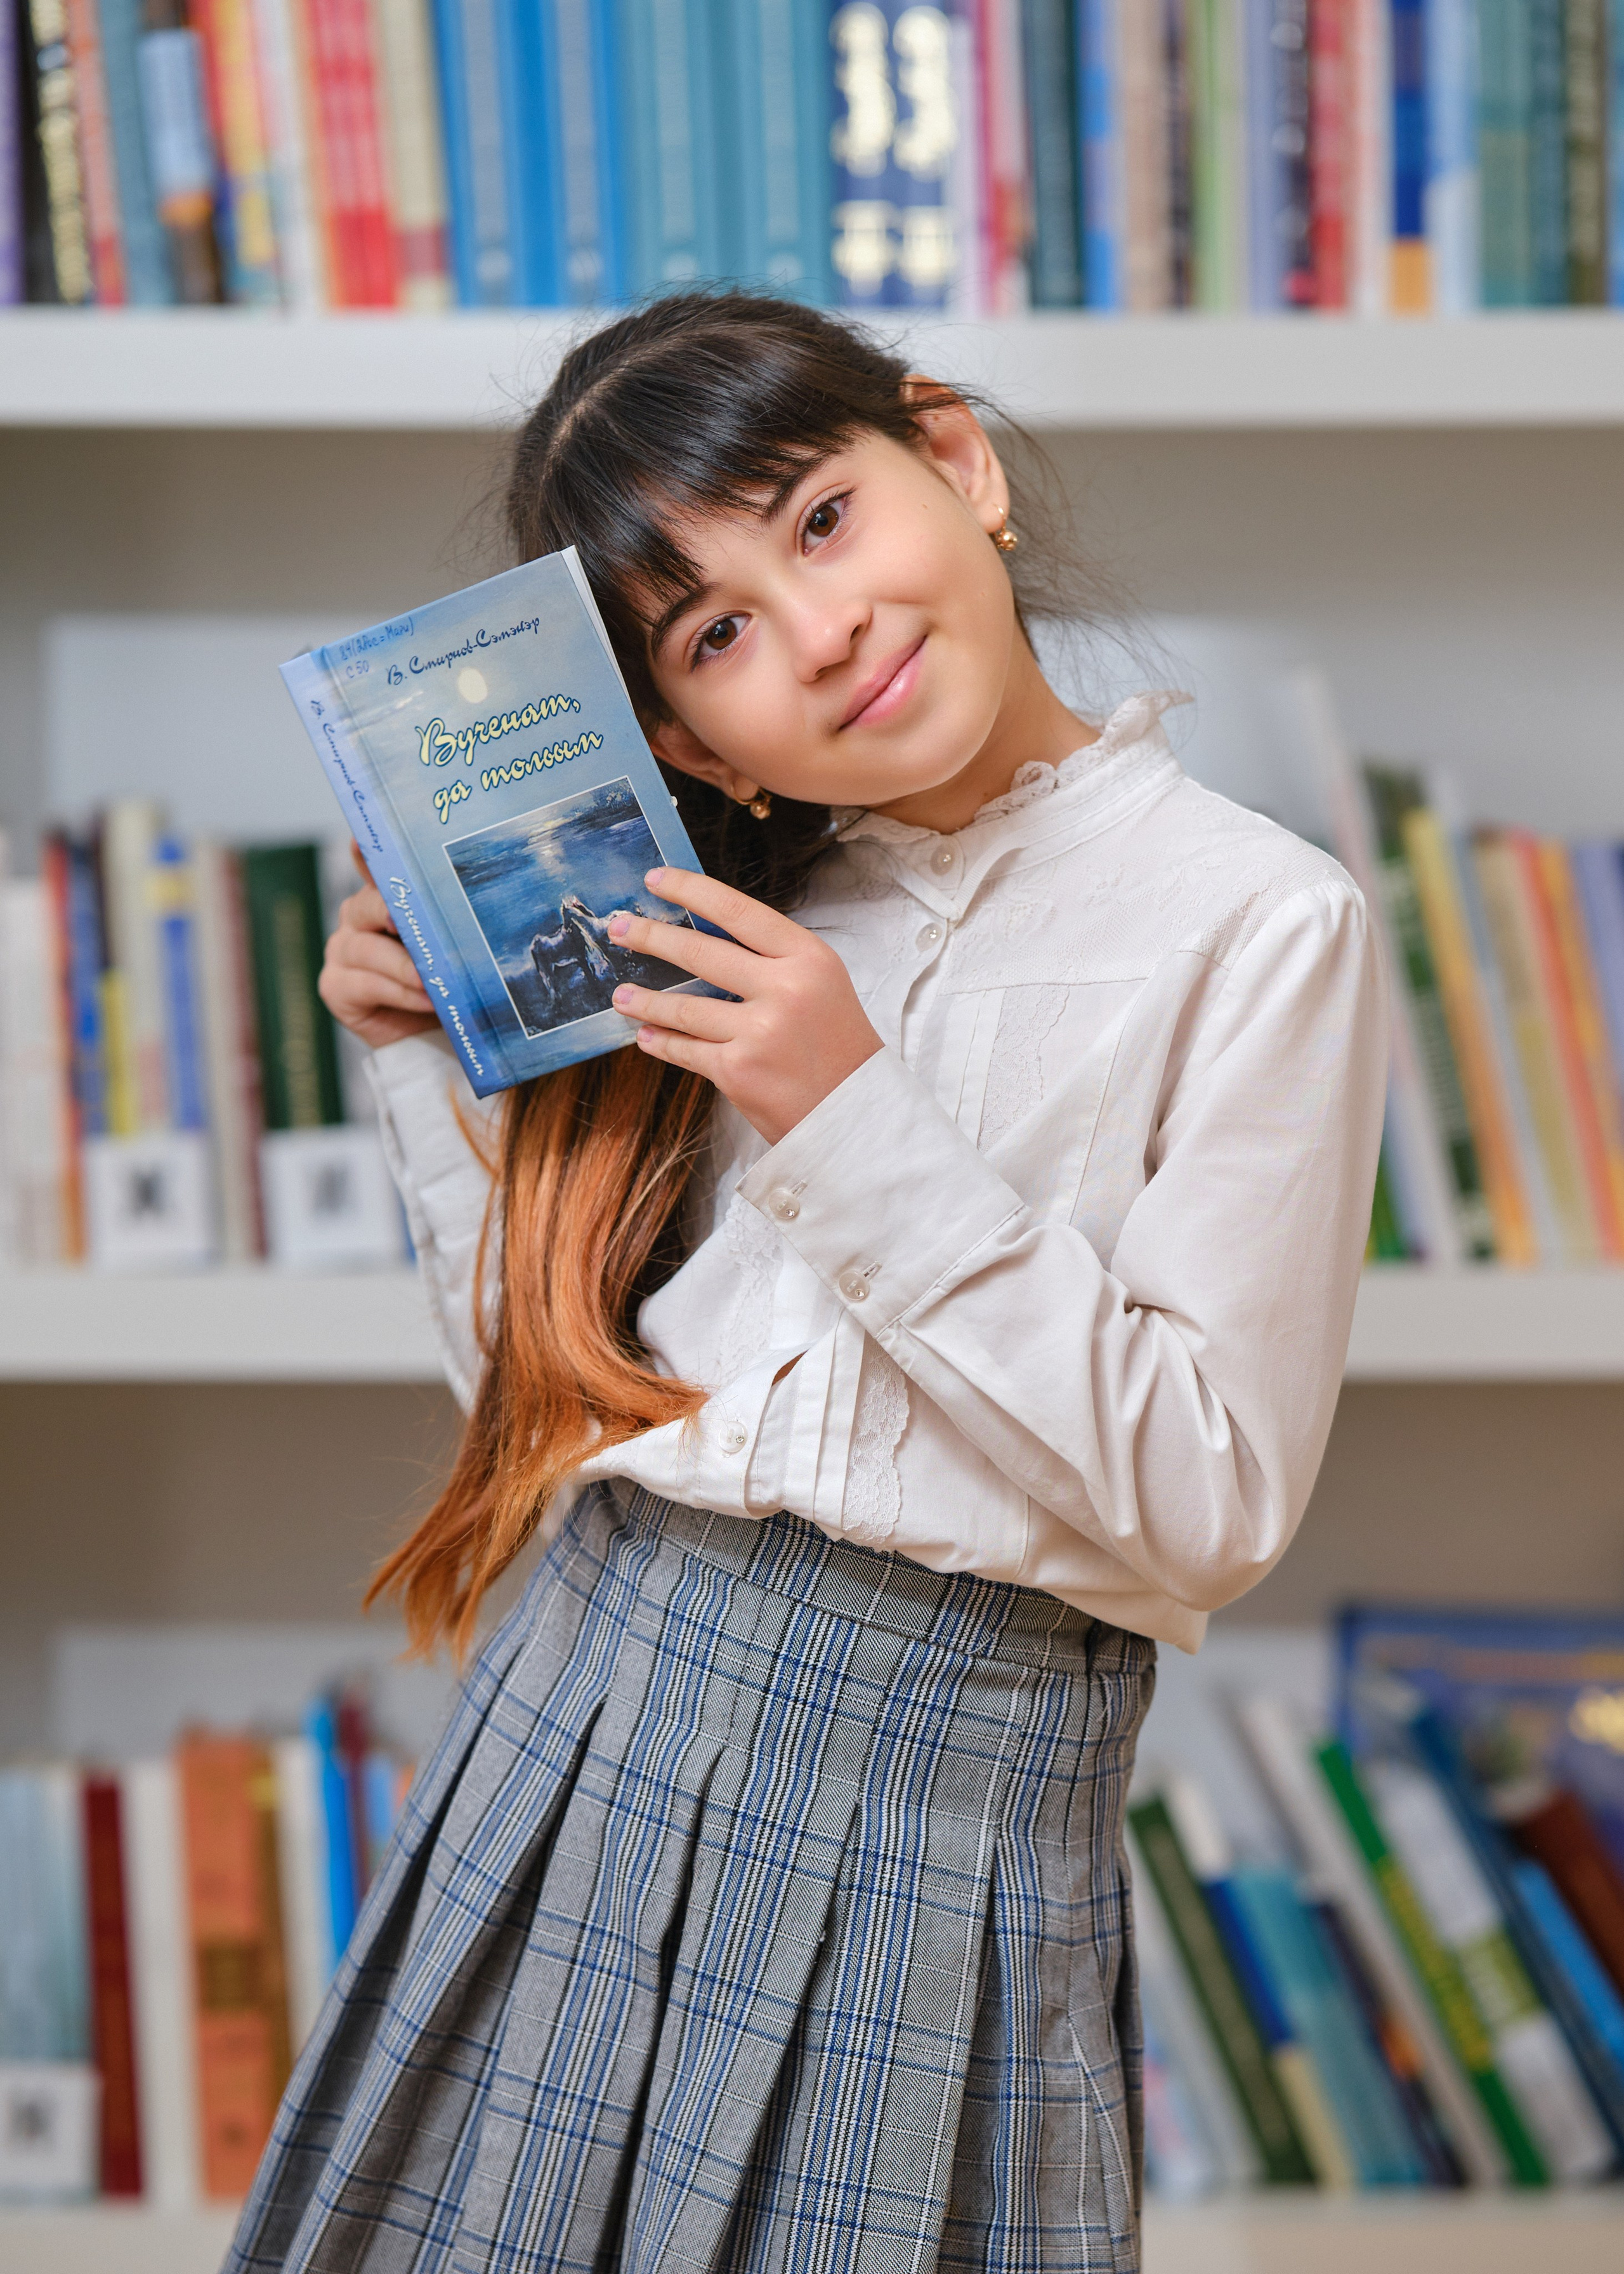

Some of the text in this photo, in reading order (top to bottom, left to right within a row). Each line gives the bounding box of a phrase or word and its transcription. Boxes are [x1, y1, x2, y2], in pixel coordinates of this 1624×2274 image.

[386, 617, 540, 685] В. Смирнов-Сэмэнэр
[311, 700, 324, 720] В.
[415, 693, 580, 766] Вученат,
[433, 730, 605, 824] да тольым
[429, 976, 449, 1000] да
